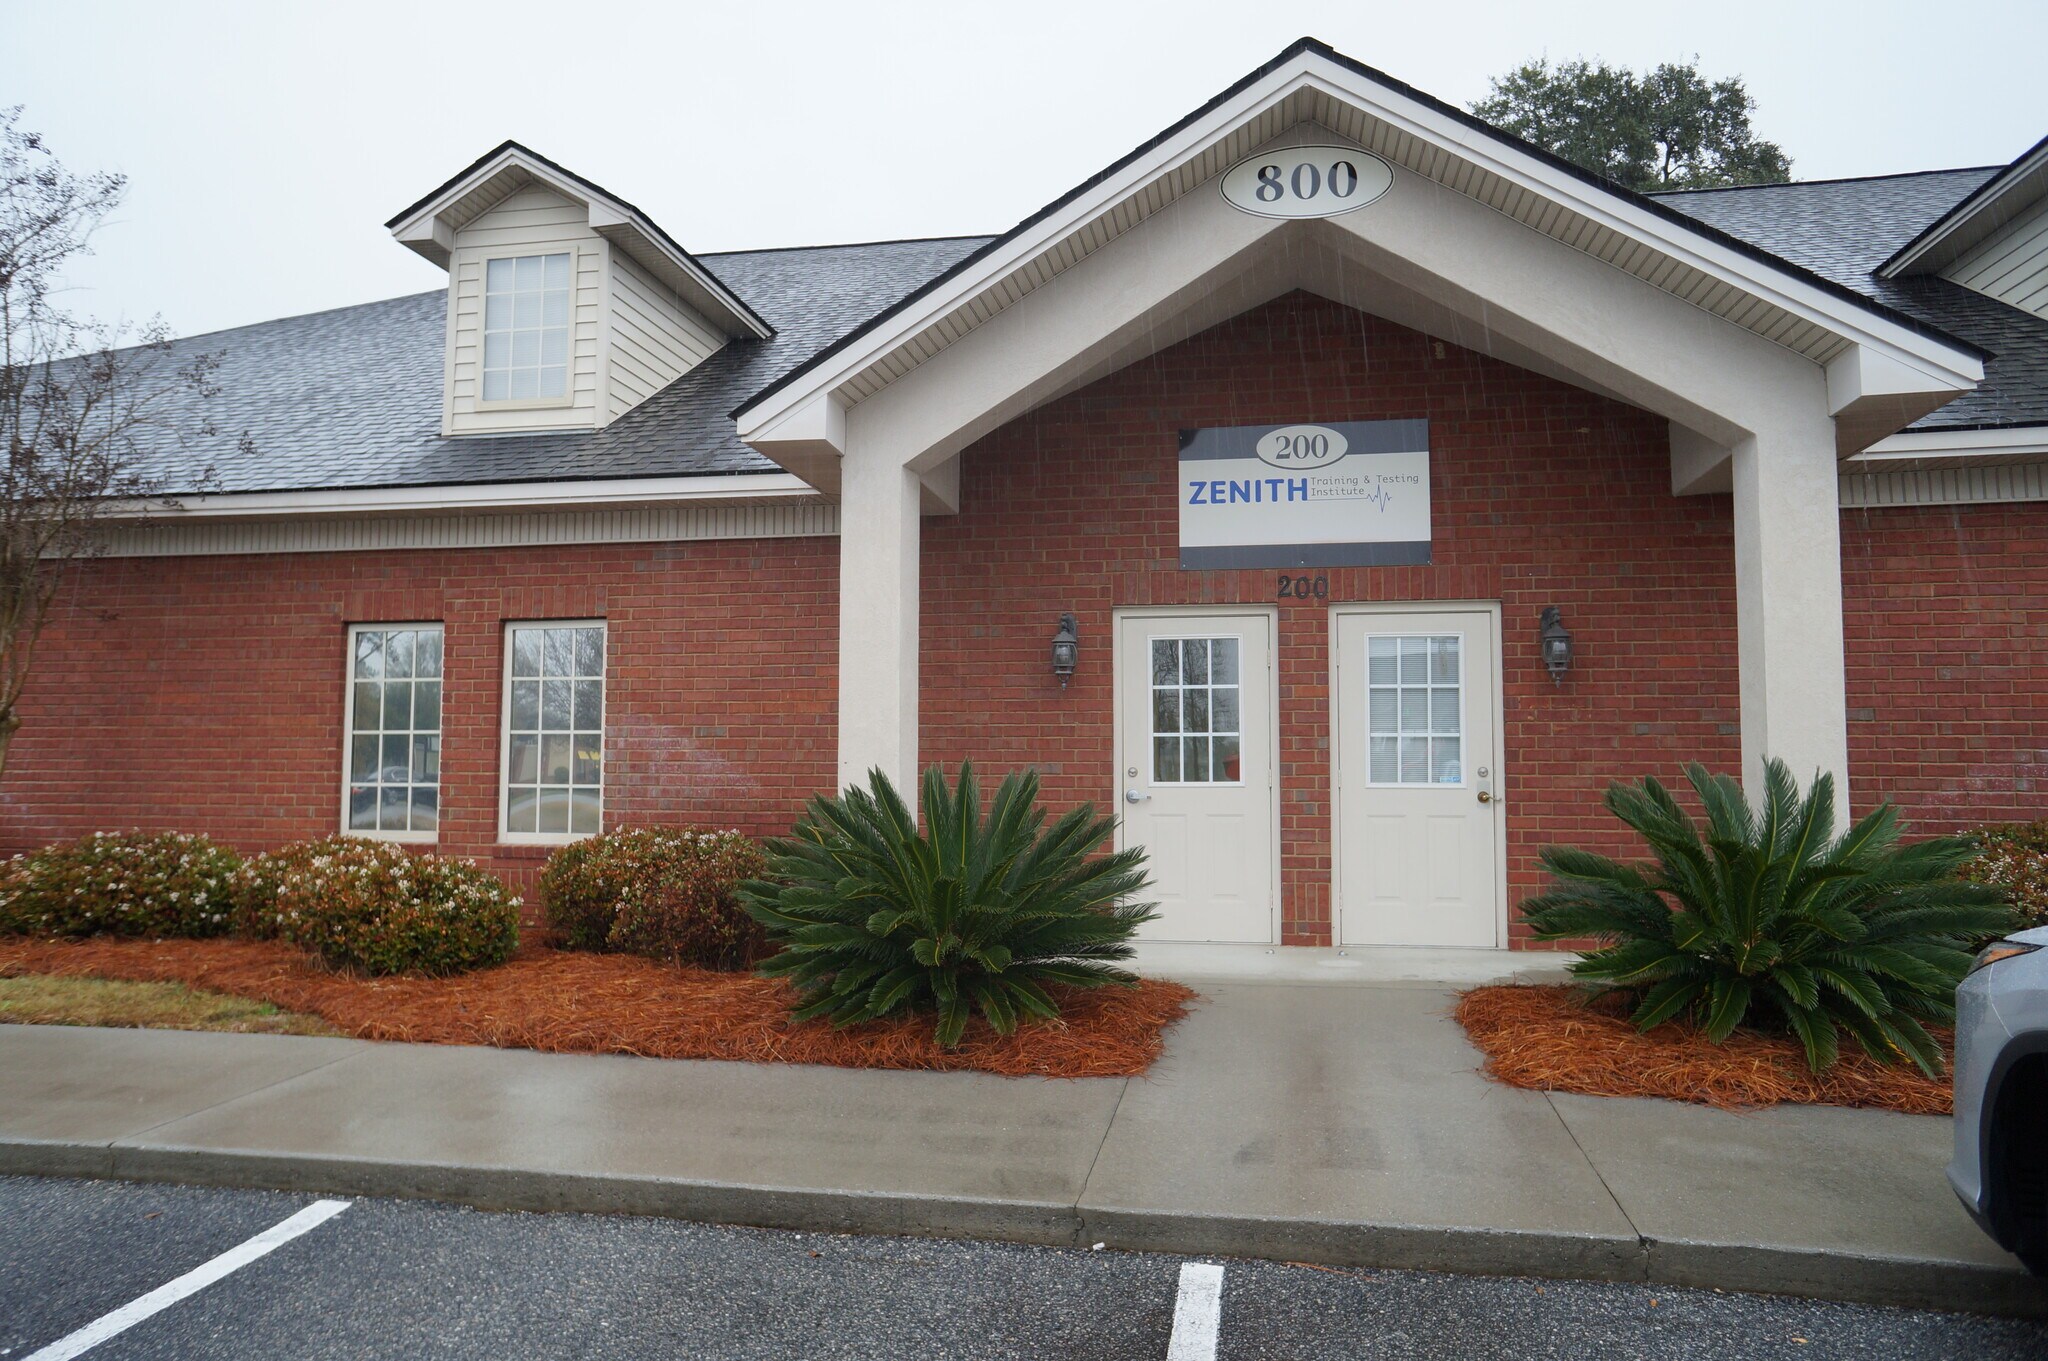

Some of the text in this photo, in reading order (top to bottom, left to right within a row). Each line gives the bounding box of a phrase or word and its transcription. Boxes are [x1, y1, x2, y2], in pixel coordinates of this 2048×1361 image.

[1255, 160, 1358, 203] 800
[1275, 433, 1329, 461] 200
[1188, 477, 1308, 505] ZENITH
[1310, 473, 1419, 487] Training & Testing
[1311, 486, 1365, 497] Institute
[1277, 575, 1328, 600] 200
